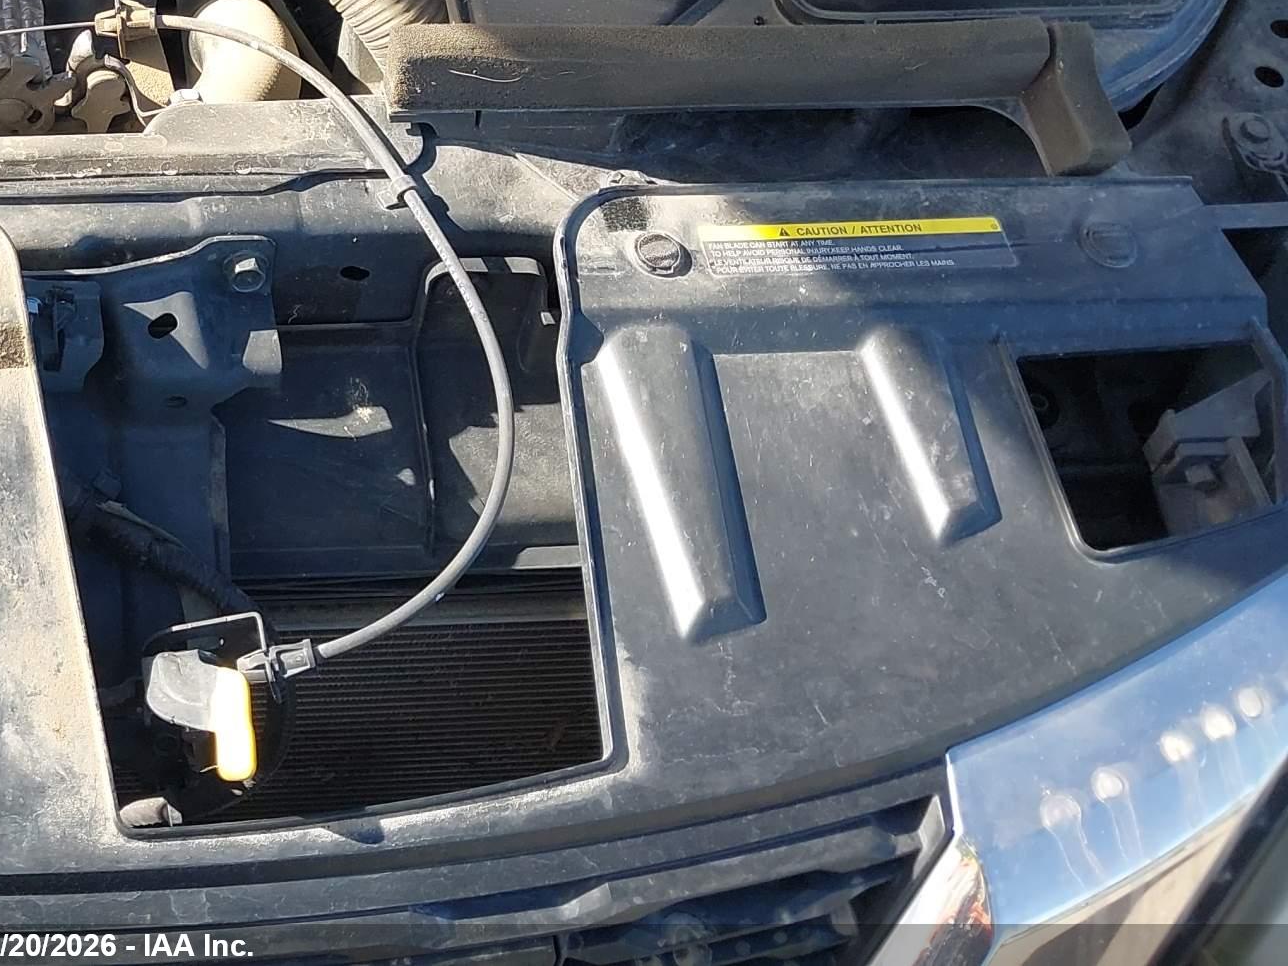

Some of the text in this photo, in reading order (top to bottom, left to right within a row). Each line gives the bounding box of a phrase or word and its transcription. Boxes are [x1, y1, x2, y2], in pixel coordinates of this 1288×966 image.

[796, 225, 849, 237] CAUTION
[861, 223, 922, 235] ATTENTION
[767, 240, 789, 248] START
[722, 249, 741, 257] HELP
[767, 247, 804, 255] PERSONAL
[852, 245, 876, 253] HANDS
[717, 266, 738, 274] POUR
[767, 264, 789, 273] TOUTE
[832, 262, 841, 270] NE
[870, 260, 916, 269] APPROCHER
